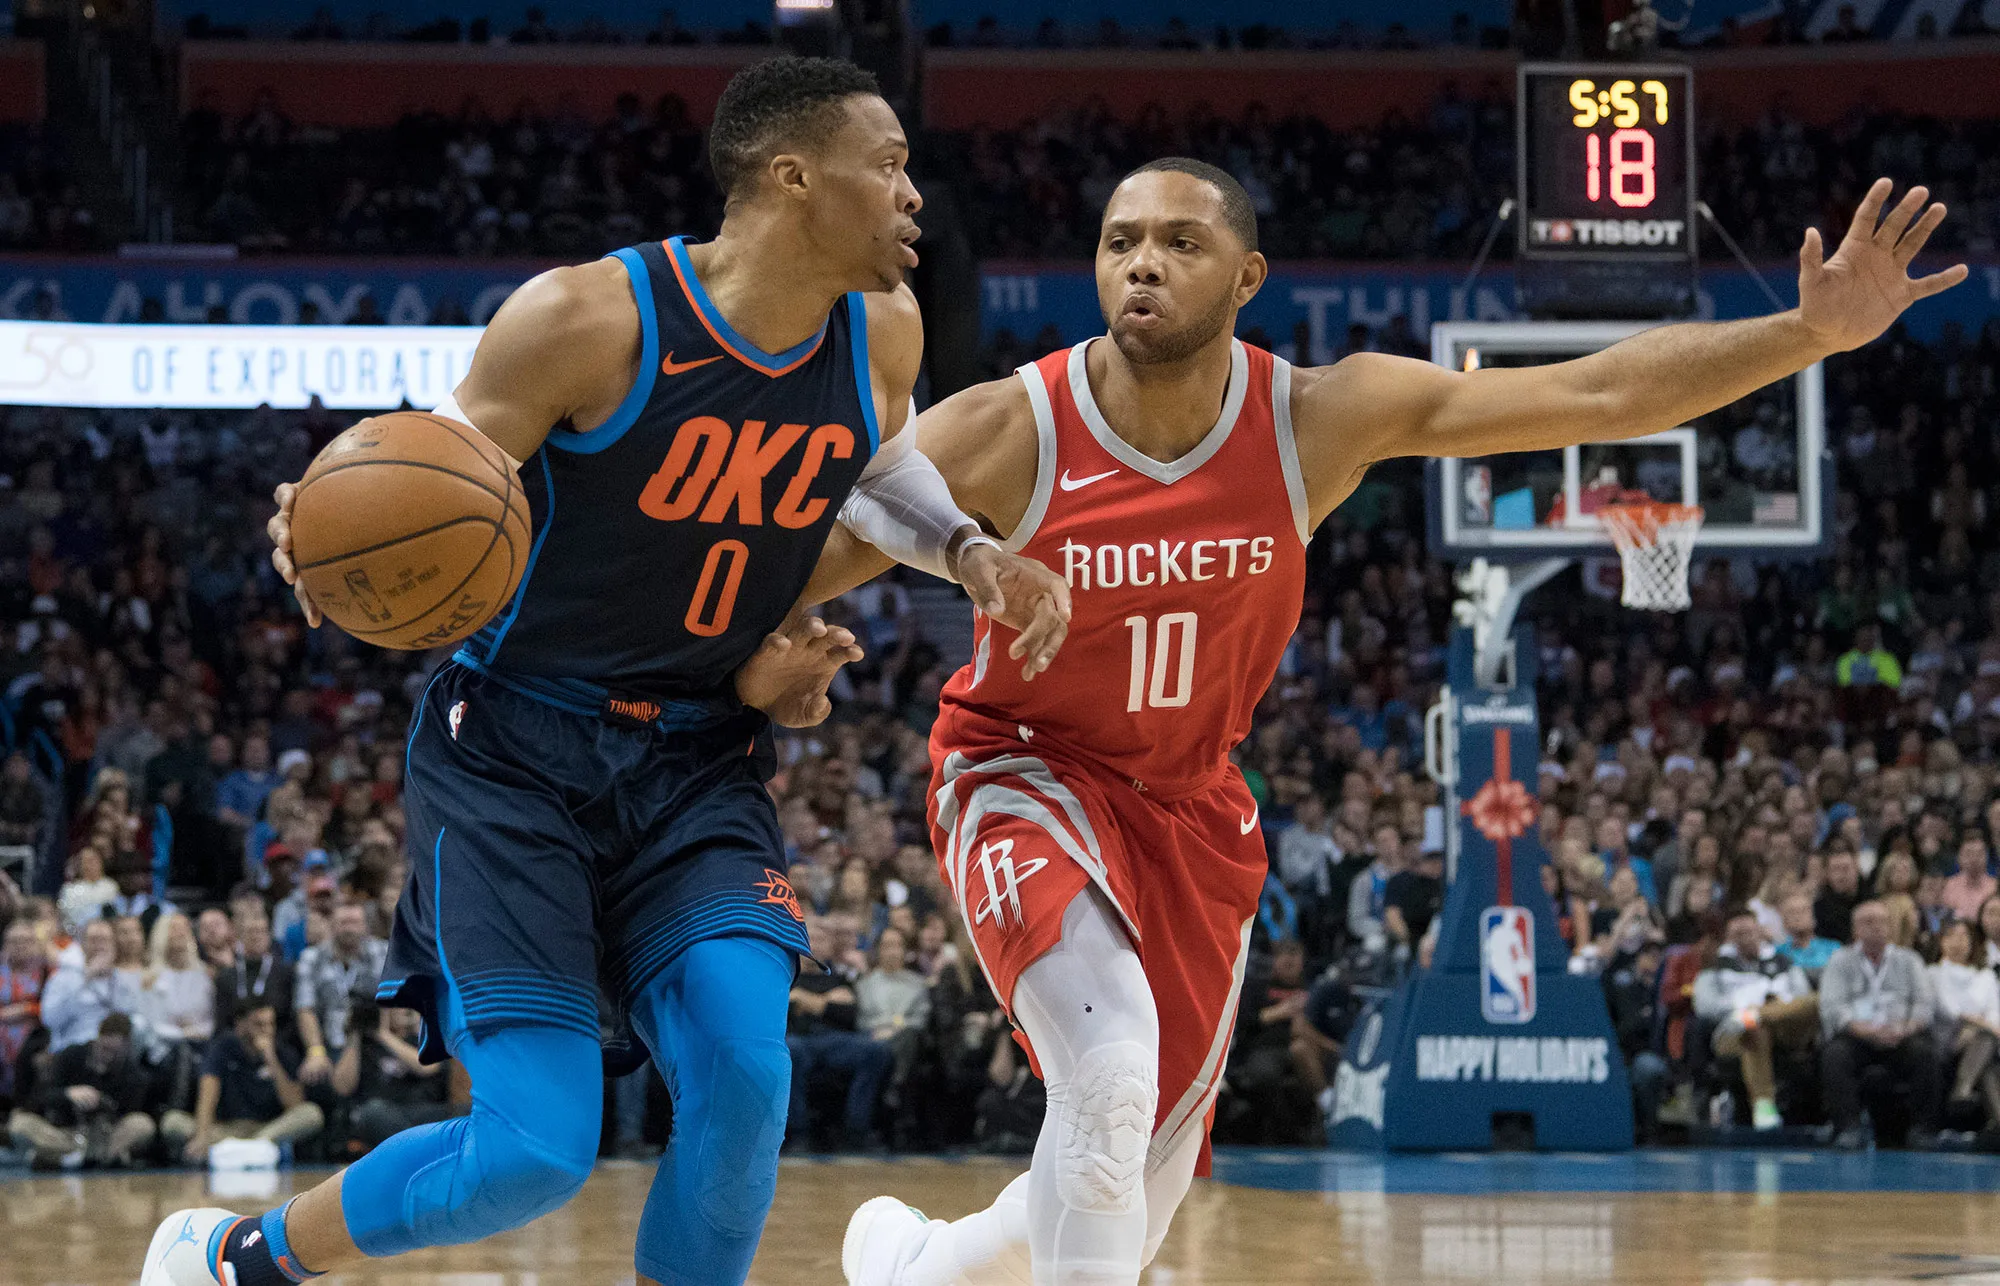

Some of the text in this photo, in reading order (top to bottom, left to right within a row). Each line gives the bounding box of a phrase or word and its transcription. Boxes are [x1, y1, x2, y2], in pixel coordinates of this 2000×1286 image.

[1568, 79, 1669, 128] 5:57
[1586, 128, 1656, 207] 18
[1575, 219, 1685, 246] TISSOT
[132, 346, 181, 395] OF
[637, 415, 855, 529] OKC
[684, 539, 749, 637] 0
[1057, 537, 1275, 591] ROCKETS
[1124, 612, 1198, 713] 10
[1416, 1035, 1609, 1084] HAPPY HOLIDAYS
